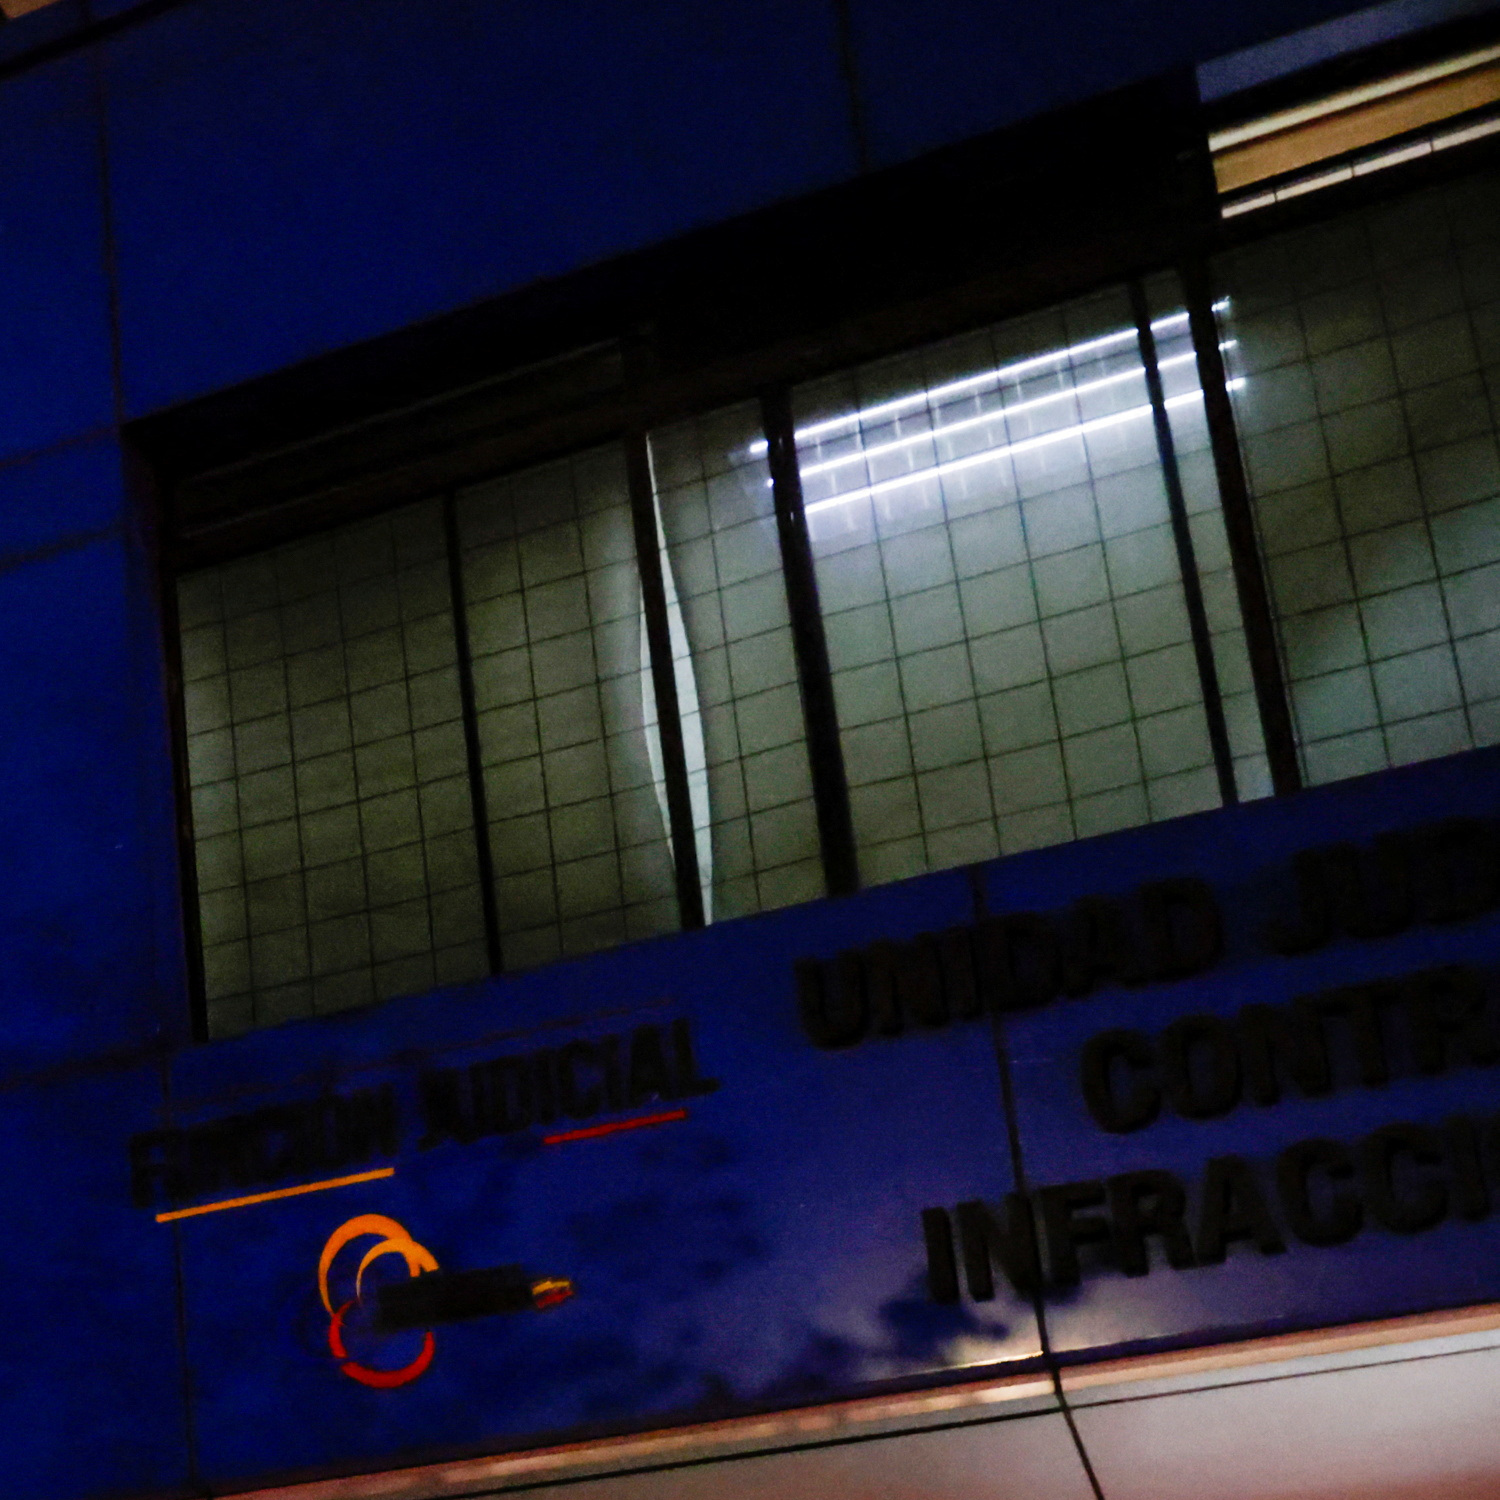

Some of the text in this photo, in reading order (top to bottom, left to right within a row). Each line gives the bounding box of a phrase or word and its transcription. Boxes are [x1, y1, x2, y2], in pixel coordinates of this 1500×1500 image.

[793, 876, 1223, 1050] UNIDAD
[415, 1017, 721, 1153] JUDICIAL
[922, 1113, 1500, 1304] INFRACCI
